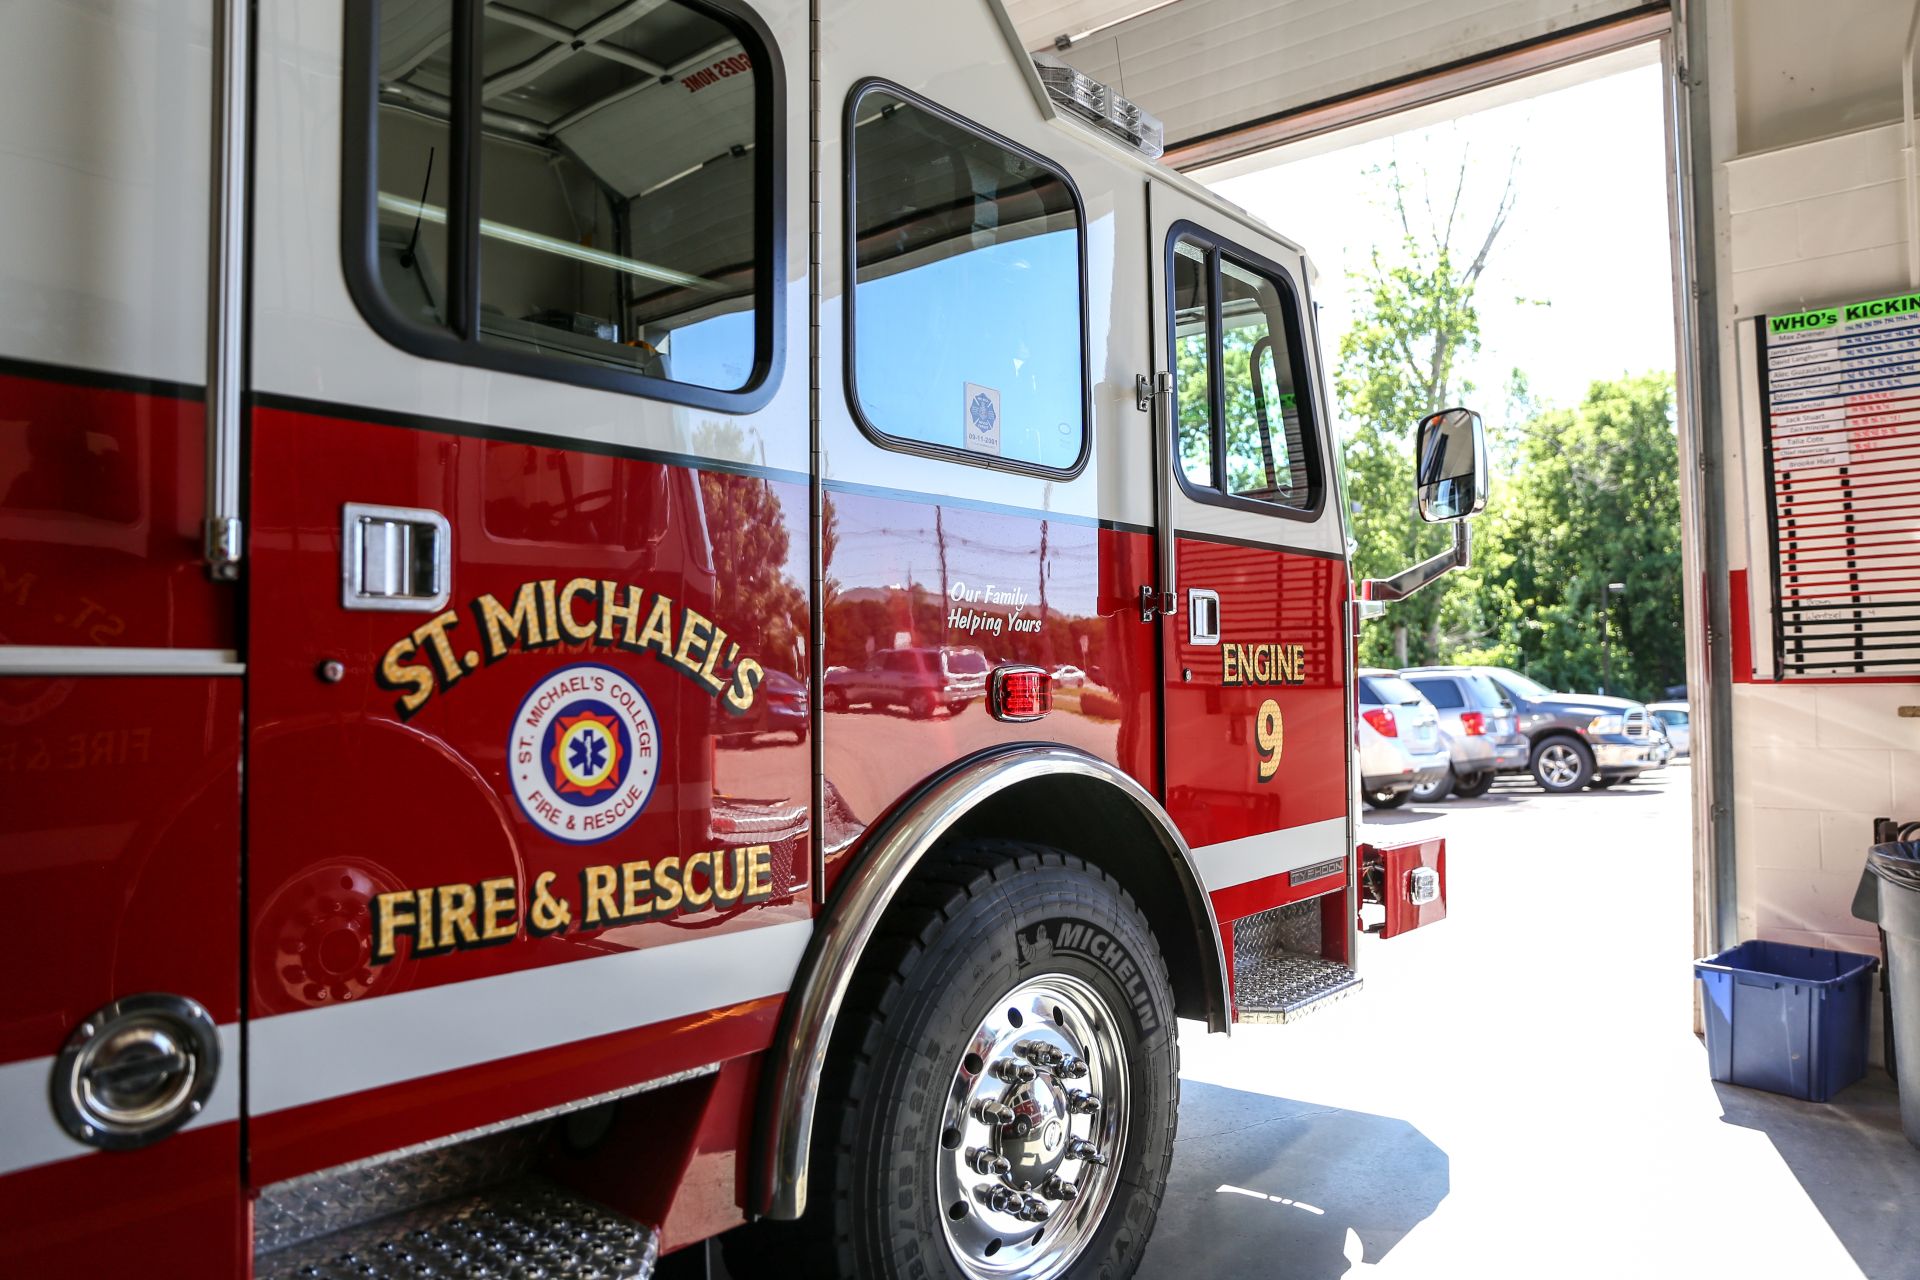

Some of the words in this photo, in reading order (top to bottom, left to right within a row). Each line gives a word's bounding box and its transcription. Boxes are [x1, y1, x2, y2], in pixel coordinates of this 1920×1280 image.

[1772, 312, 1837, 331] WHO's
[1846, 297, 1920, 320] KICKIN
[950, 582, 981, 602] Our
[984, 584, 1028, 611] Family
[947, 608, 1002, 636] Helping
[1007, 612, 1042, 633] Yours
[378, 610, 480, 720] ST.
[473, 578, 765, 713] MICHAEL'S
[1222, 643, 1305, 685] ENGINE
[526, 676, 605, 727] MICHAEL'S
[610, 684, 651, 758] COLLEGE
[519, 736, 535, 764] ST.
[1256, 699, 1284, 781] 9
[528, 790, 562, 825] FIRE
[566, 815, 576, 830] &
[583, 785, 643, 831] RESCUE
[1290, 859, 1344, 884] TYPHOON
[373, 878, 518, 964] FIRE
[527, 872, 572, 934] &
[580, 845, 772, 927] RESCUE
[1055, 923, 1157, 1031] MICHELIN
